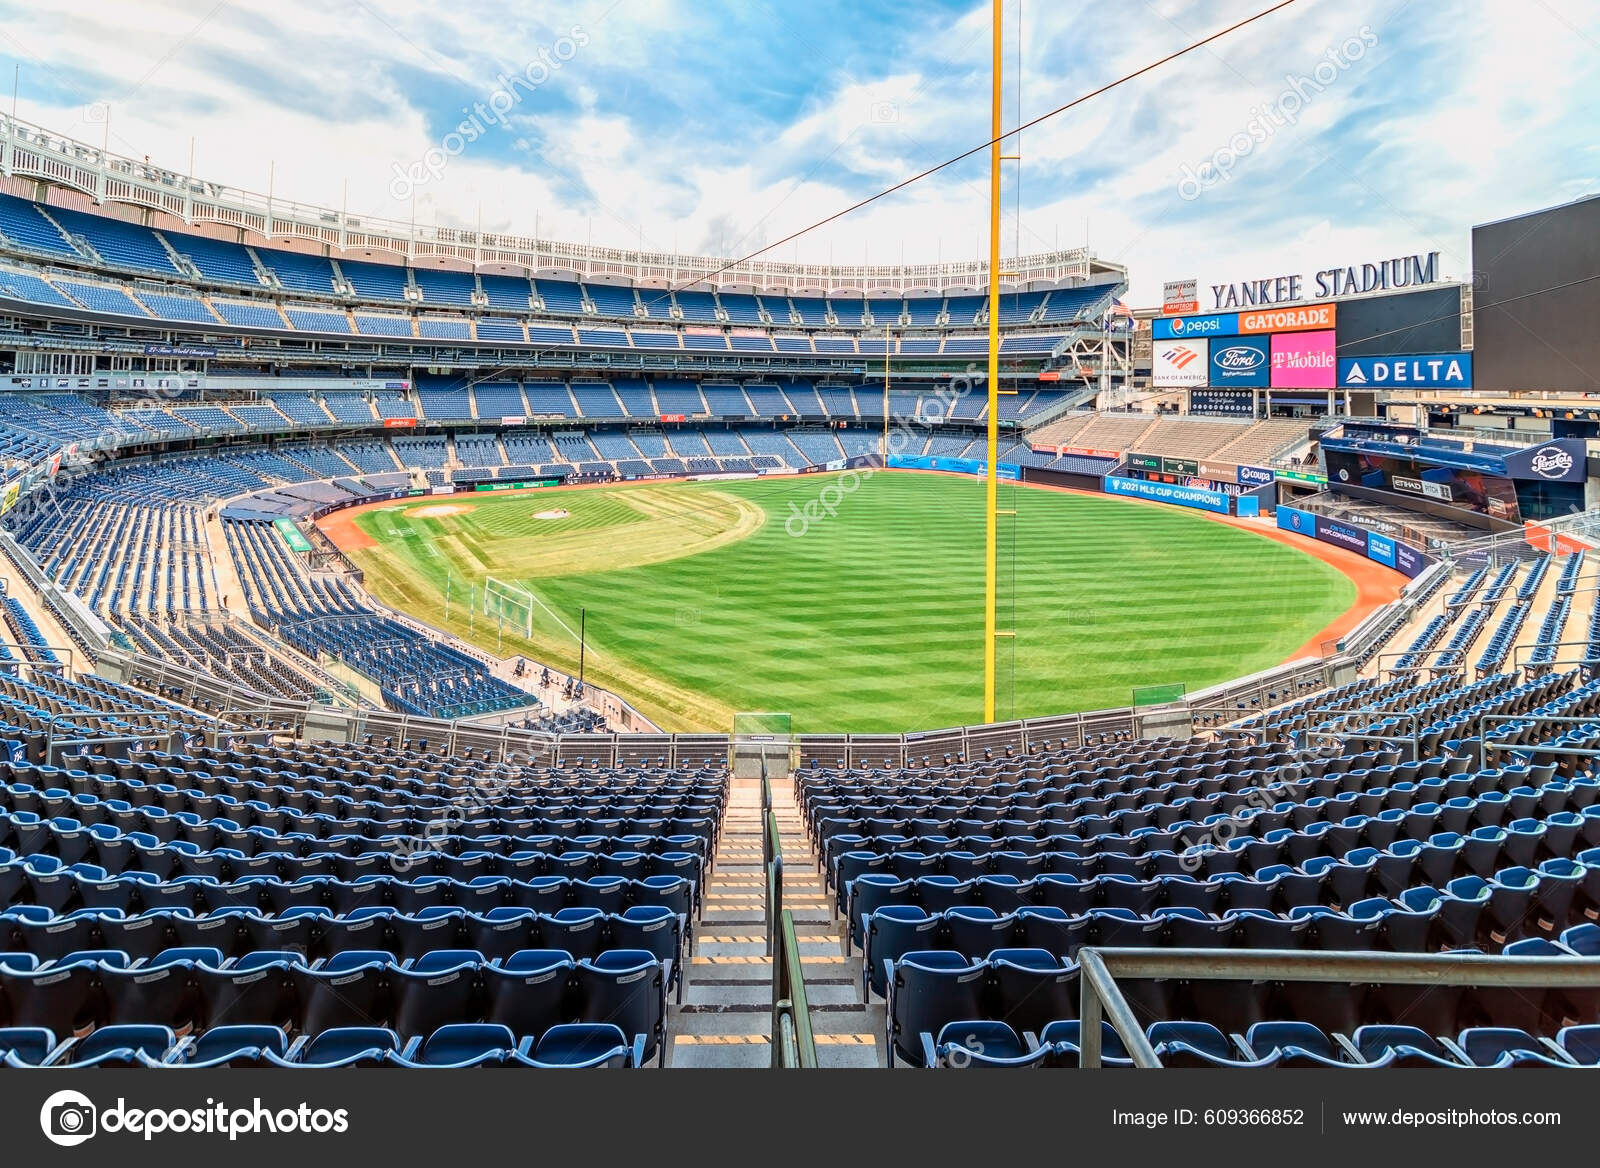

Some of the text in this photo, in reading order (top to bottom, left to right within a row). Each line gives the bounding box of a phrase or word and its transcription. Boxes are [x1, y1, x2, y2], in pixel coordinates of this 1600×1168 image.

[1212, 251, 1440, 308] YANKEE STADIUM
[1186, 317, 1220, 334] pepsi
[1245, 308, 1329, 330] GATORADE
[1222, 349, 1255, 366] Ford
[1287, 351, 1335, 369] Mobile
[1373, 359, 1464, 381] DELTA
[1250, 470, 1270, 482] coupa
[1121, 481, 1221, 506] 2021 MLS CUP CHAMPIONS
